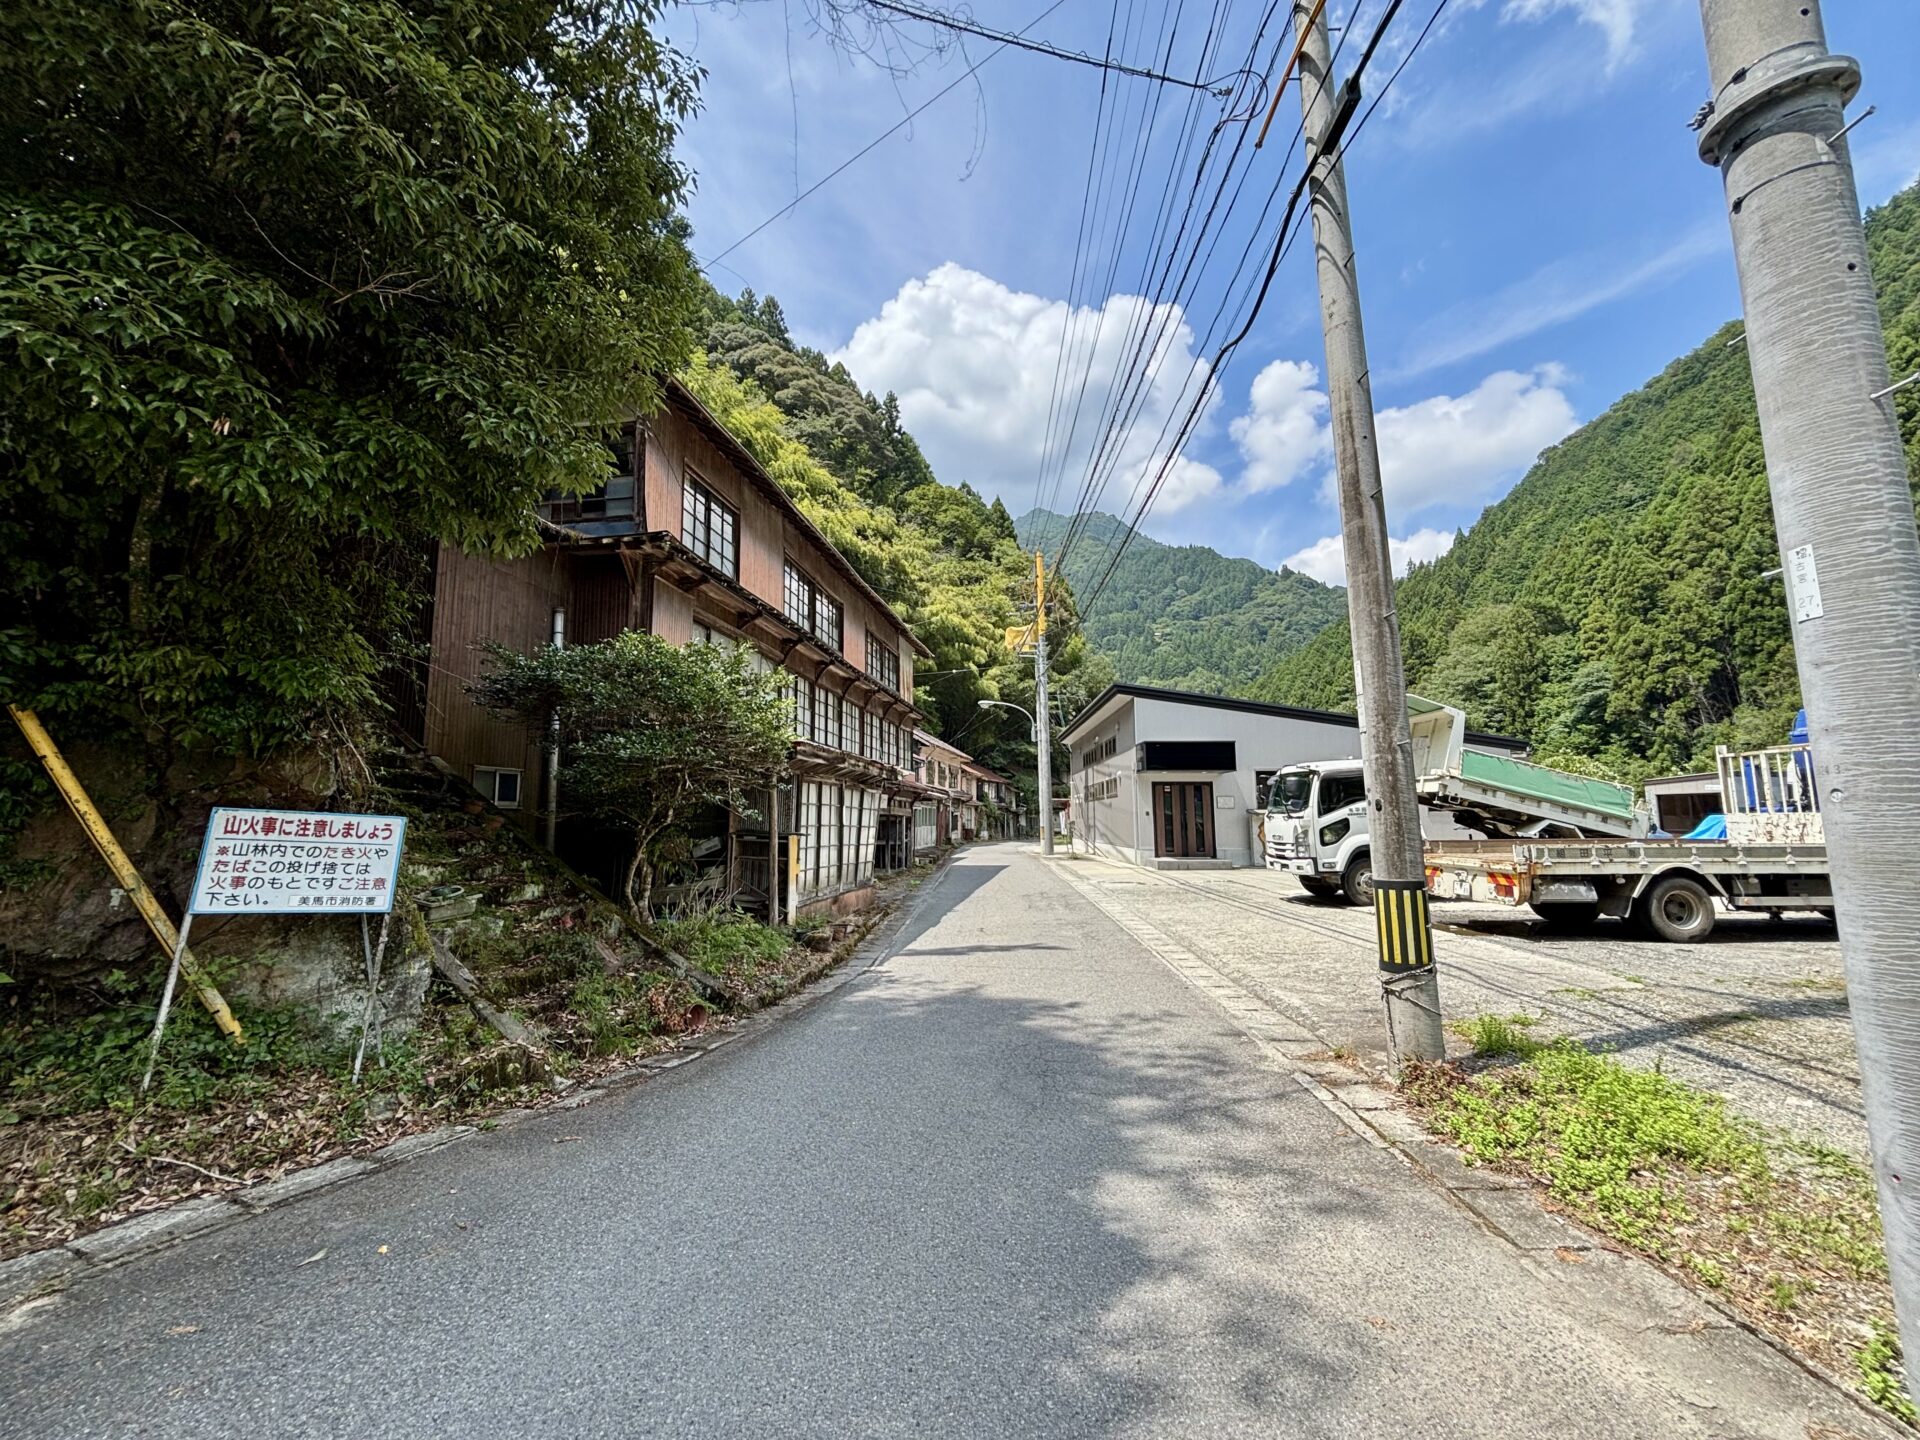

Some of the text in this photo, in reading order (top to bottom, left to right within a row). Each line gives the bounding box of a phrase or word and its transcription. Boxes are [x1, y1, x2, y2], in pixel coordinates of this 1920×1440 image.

[1798, 595, 1815, 609] 27
[223, 815, 393, 841] 山火事に注意しましょう
[211, 859, 371, 875] たばこの投げ捨ては
[207, 875, 387, 891] 火事のもとですご注意
[205, 892, 269, 907] 下さい。
[297, 896, 377, 906] 美馬市消防署
